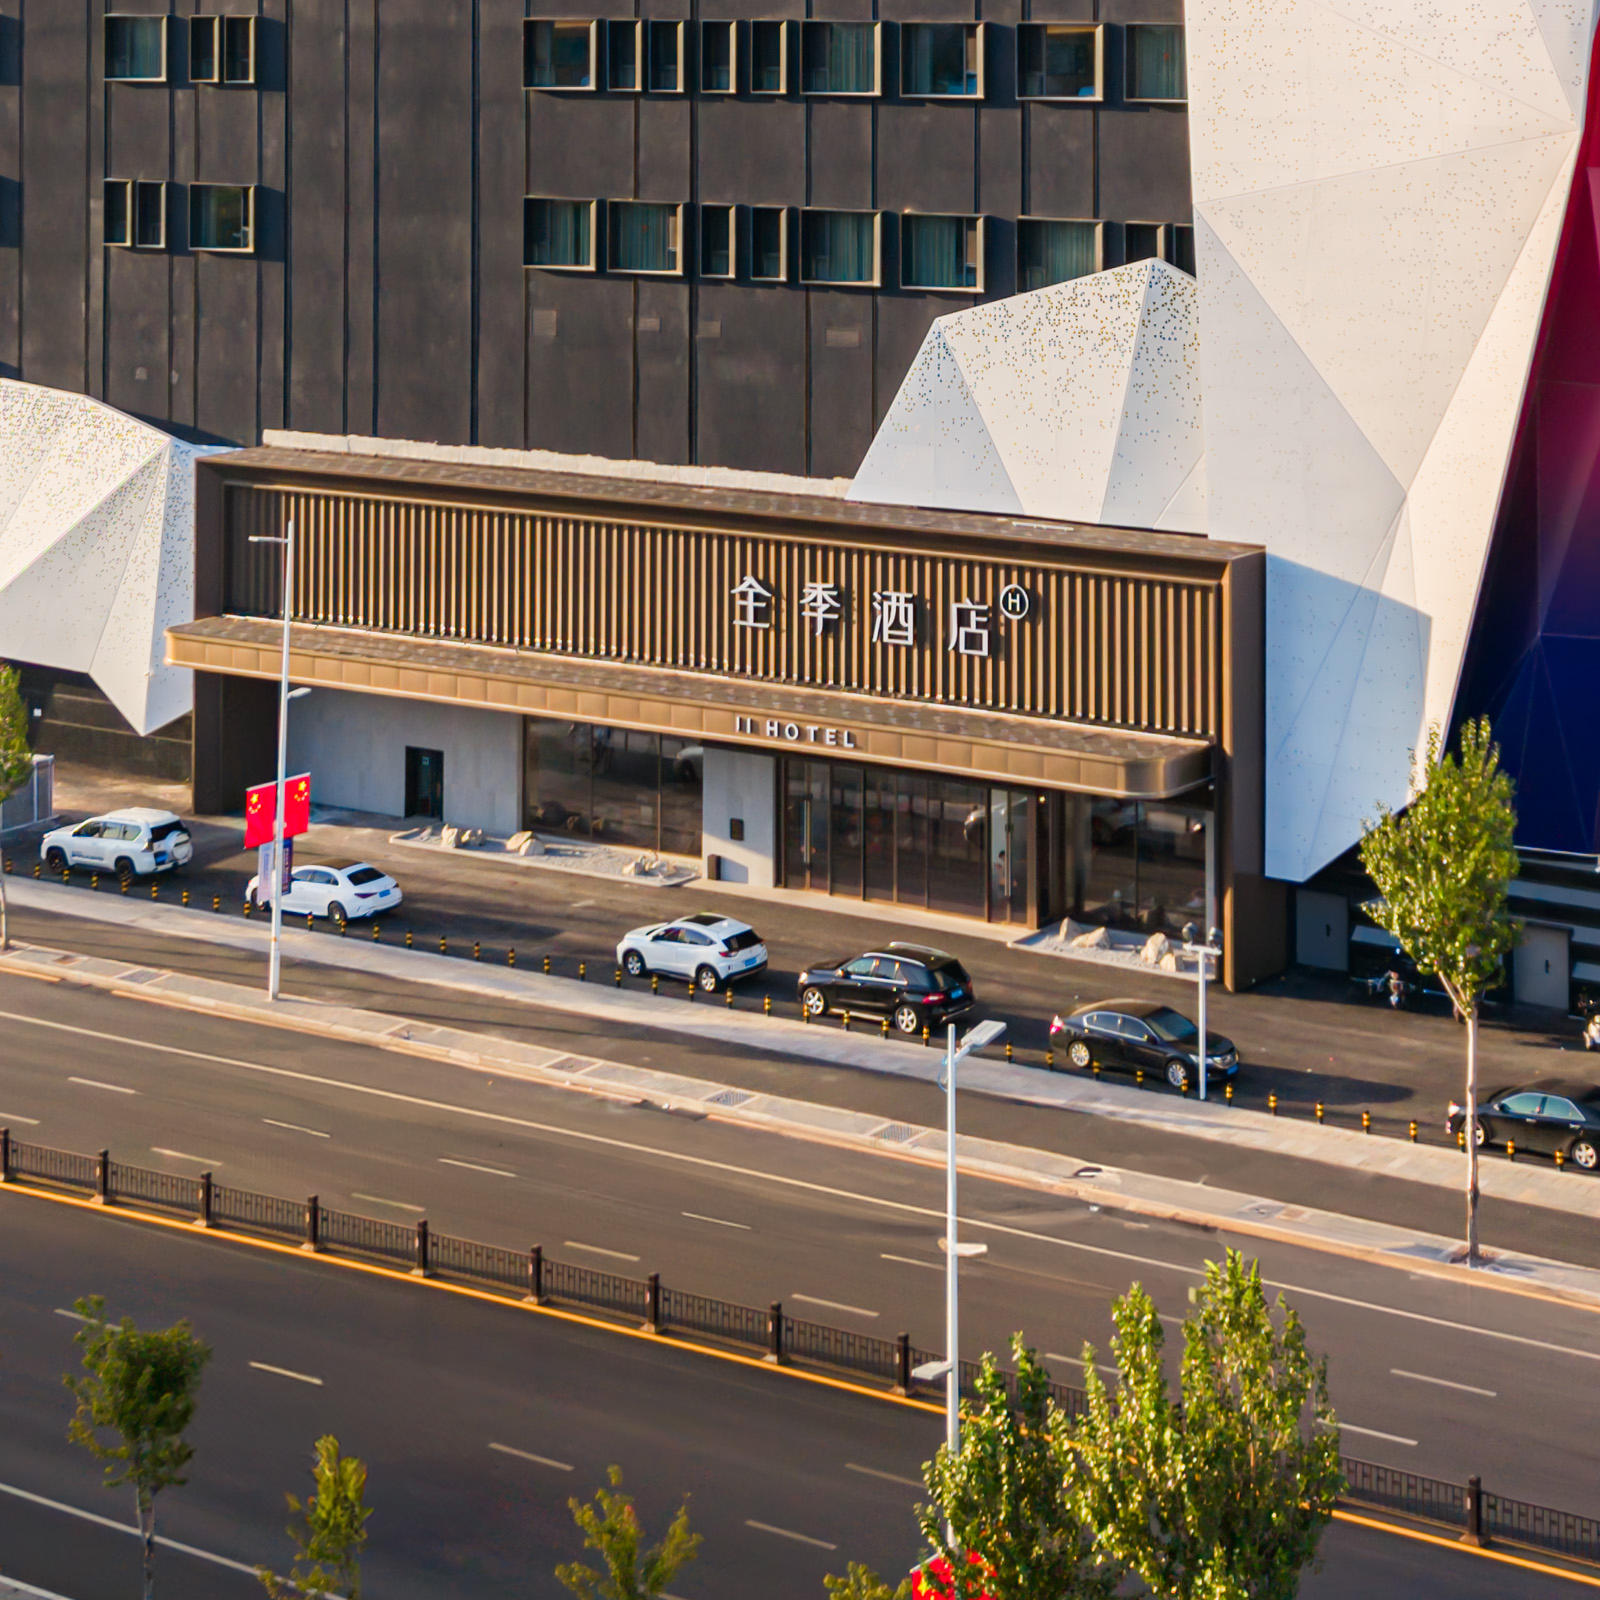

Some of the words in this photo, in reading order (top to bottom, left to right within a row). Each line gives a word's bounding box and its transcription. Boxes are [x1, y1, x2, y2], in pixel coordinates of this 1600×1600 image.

[730, 575, 989, 657] 全季酒店
[766, 719, 855, 748] HOTEL
